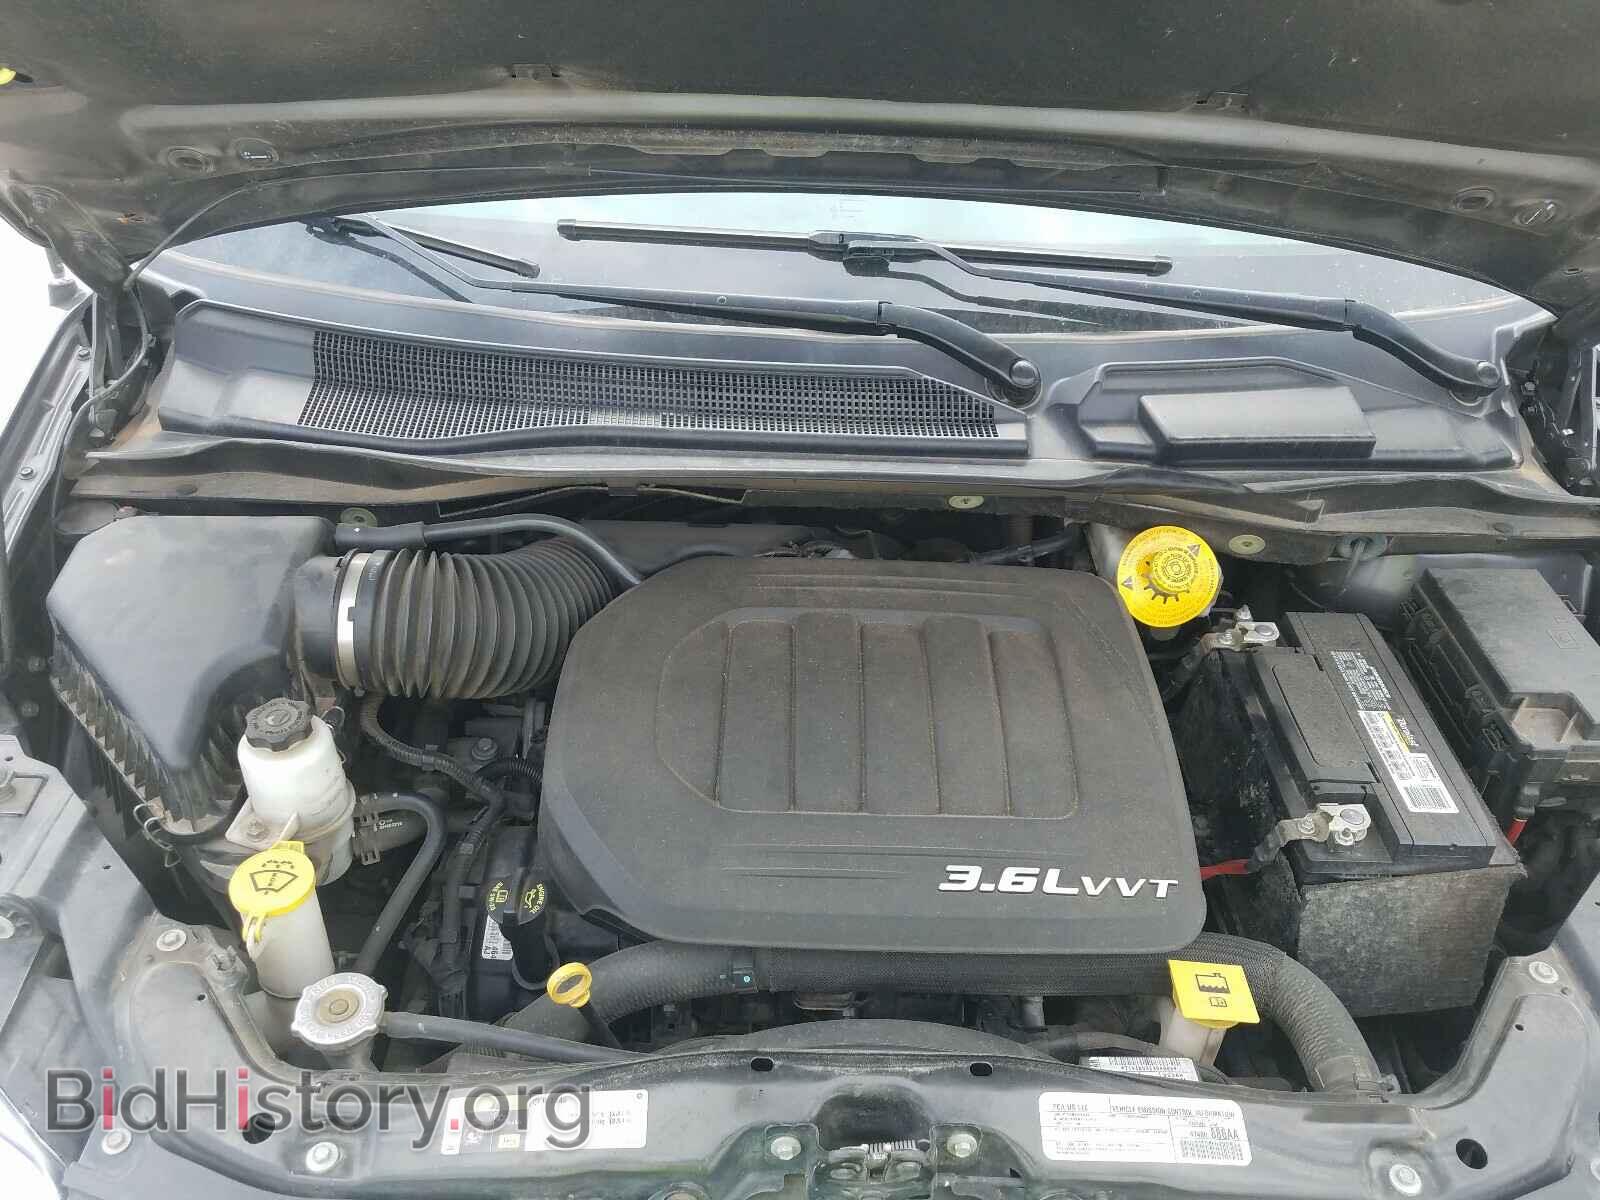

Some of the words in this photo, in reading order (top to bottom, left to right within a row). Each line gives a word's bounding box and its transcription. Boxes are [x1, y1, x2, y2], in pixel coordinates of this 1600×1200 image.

[537, 883, 545, 905] ENGINE
[529, 904, 540, 914] OIL
[1111, 1105, 1136, 1114] VEHICLE
[1137, 1106, 1167, 1115] EMISSION
[1168, 1108, 1193, 1117] CONTROL
[1195, 1109, 1236, 1119] INFORMATION
